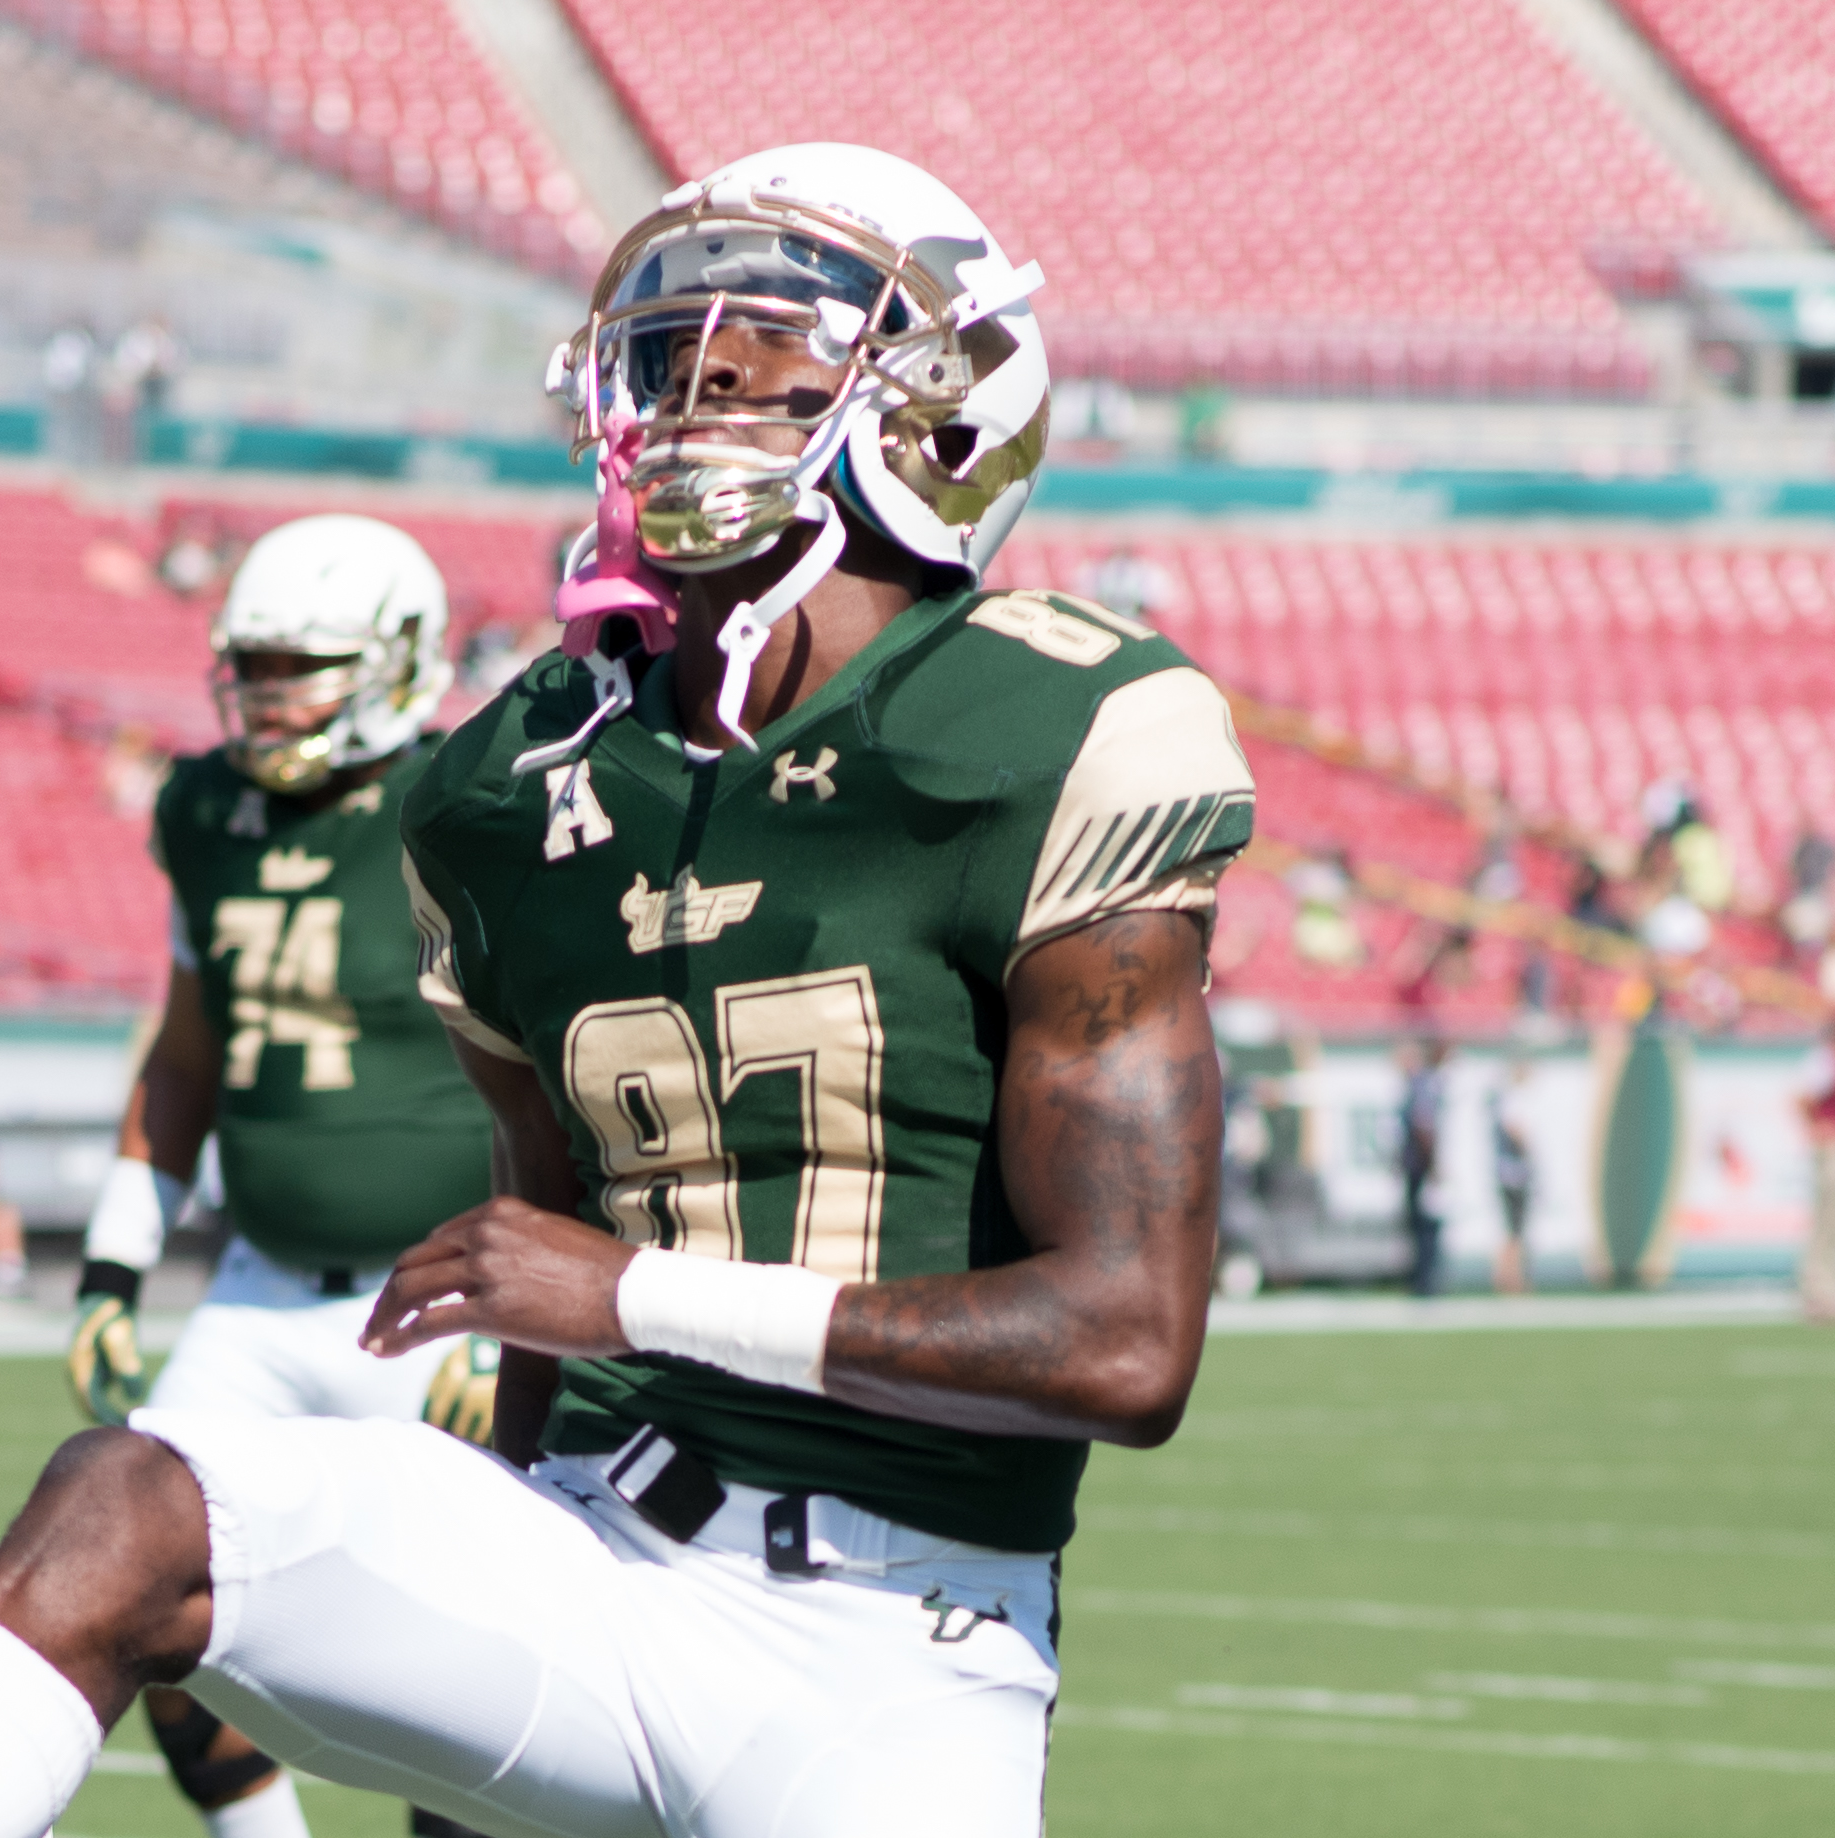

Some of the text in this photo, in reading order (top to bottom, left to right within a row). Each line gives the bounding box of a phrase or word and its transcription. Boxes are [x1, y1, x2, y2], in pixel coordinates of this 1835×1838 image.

[210, 896, 362, 1092] 74
[620, 862, 763, 955] USF
[563, 964, 885, 1287] 87
